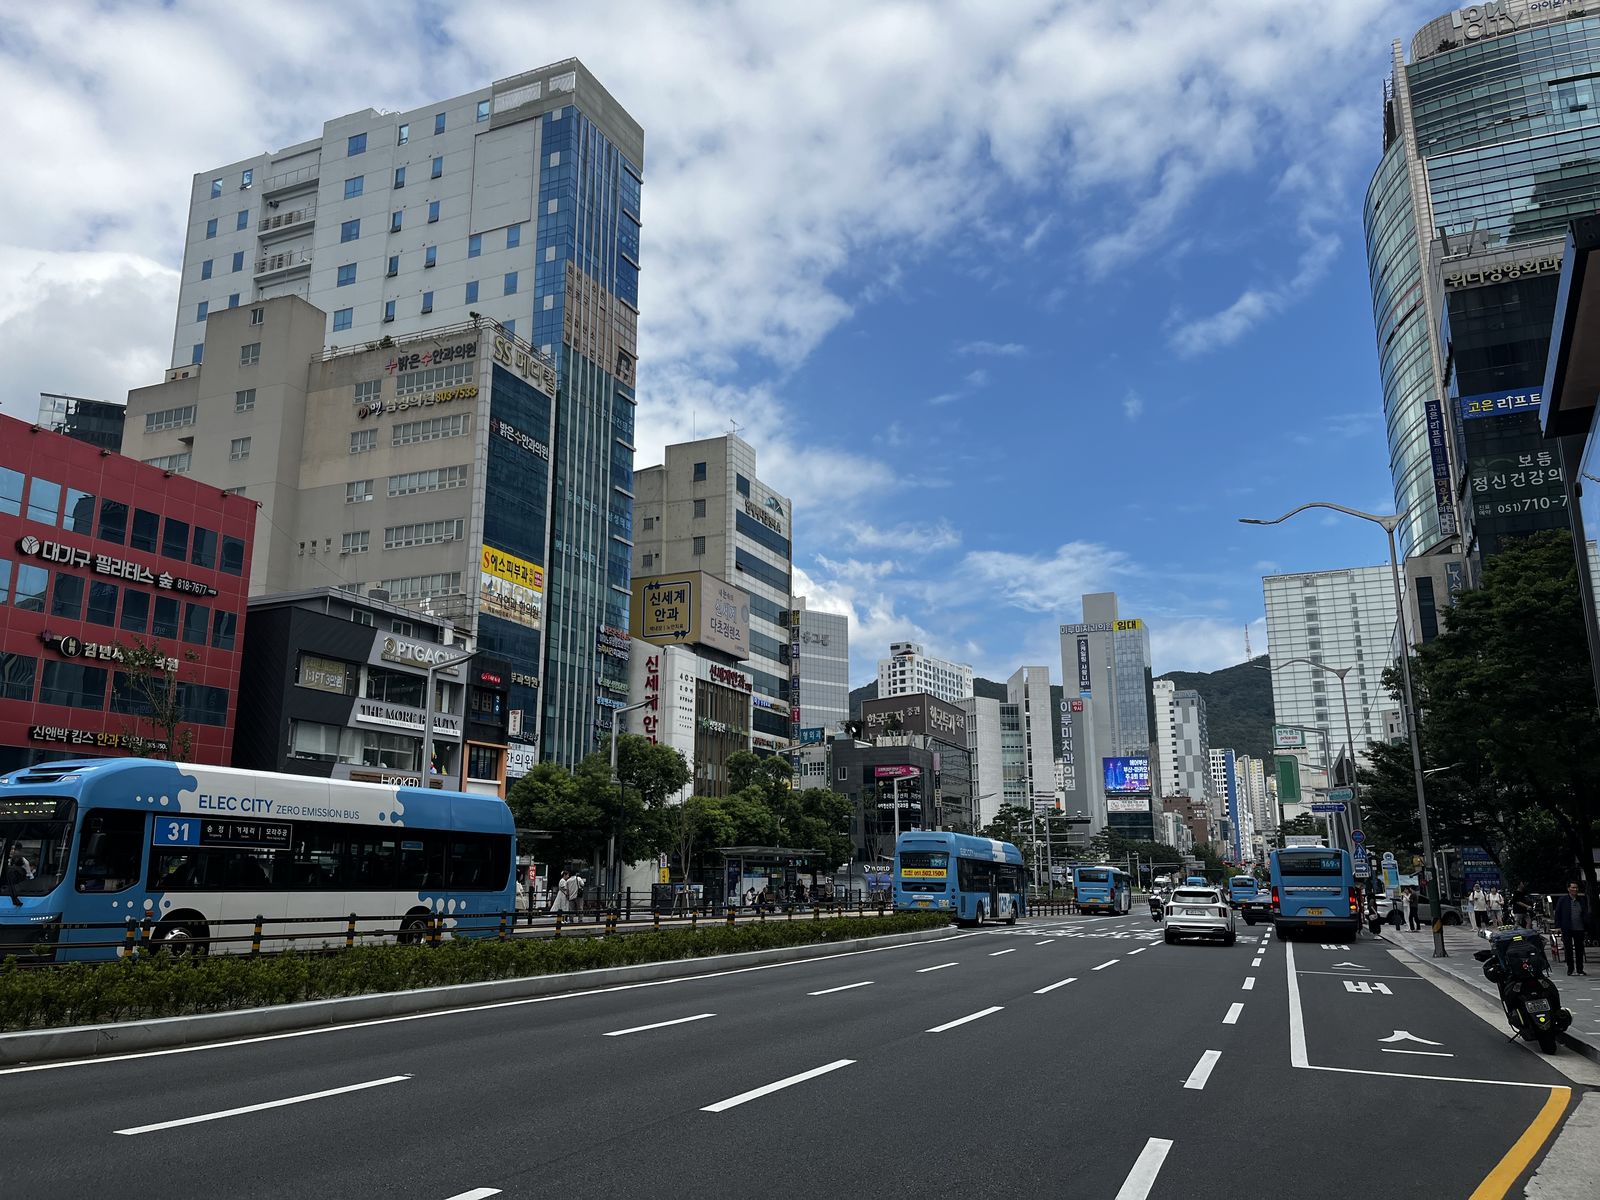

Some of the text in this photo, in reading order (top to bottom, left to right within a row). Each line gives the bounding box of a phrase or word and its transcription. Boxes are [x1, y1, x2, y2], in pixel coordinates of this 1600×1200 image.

[1464, 11, 1524, 40] CITY
[398, 342, 477, 372] 밝은수안과의원
[494, 337, 556, 396] SS 메디컬
[1468, 393, 1542, 413] 고은 리프트
[500, 421, 549, 461] 밝은수안과의원
[1518, 451, 1552, 468] 보듬
[1473, 467, 1564, 491] 정신건강의
[42, 540, 207, 596] 대기구 필라테스 숲 818-7677
[490, 554, 529, 584] 에스피부과
[650, 589, 685, 606] 신세계
[519, 601, 539, 619] 한의원
[655, 607, 679, 622] 안과
[711, 617, 741, 641] 다초점렌즈
[1117, 620, 1136, 631] 임대
[361, 704, 458, 730] THE MORE BAUTY
[907, 706, 921, 716] 증권
[33, 726, 68, 743] 신앤박
[71, 730, 94, 745] 킴스
[97, 733, 119, 748] 안과
[1060, 701, 1076, 791] 이루미치과의원
[198, 794, 360, 820] ELEC CITY ZERO EMISSION BUS
[167, 821, 190, 841] 31
